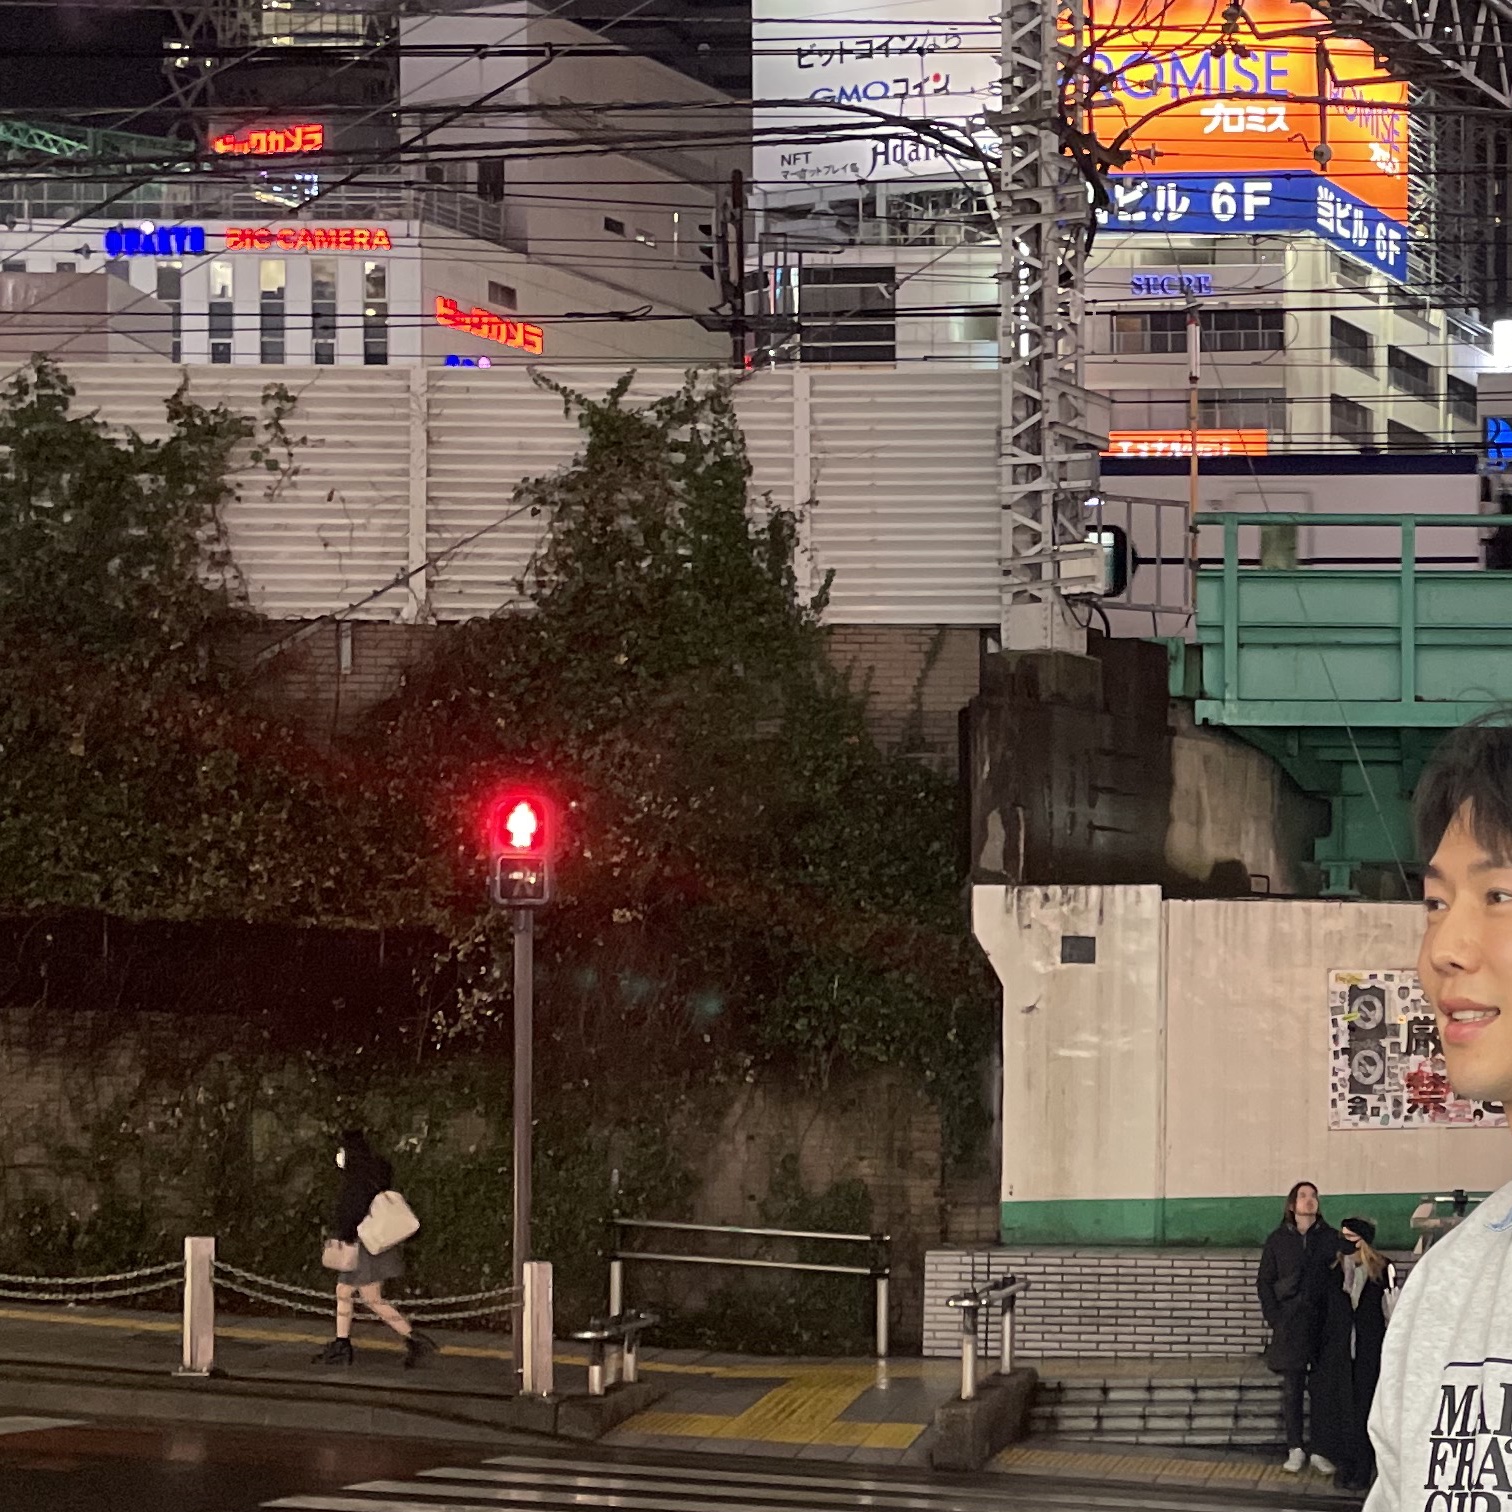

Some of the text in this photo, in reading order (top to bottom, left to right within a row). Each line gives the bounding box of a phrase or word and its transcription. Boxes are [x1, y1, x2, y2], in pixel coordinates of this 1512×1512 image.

[1200, 103, 1290, 134] プロミス
[780, 151, 812, 167] NFT
[1211, 181, 1273, 222] 6F
[225, 227, 392, 251] BIC CAMERA
[1374, 221, 1402, 266] 6F
